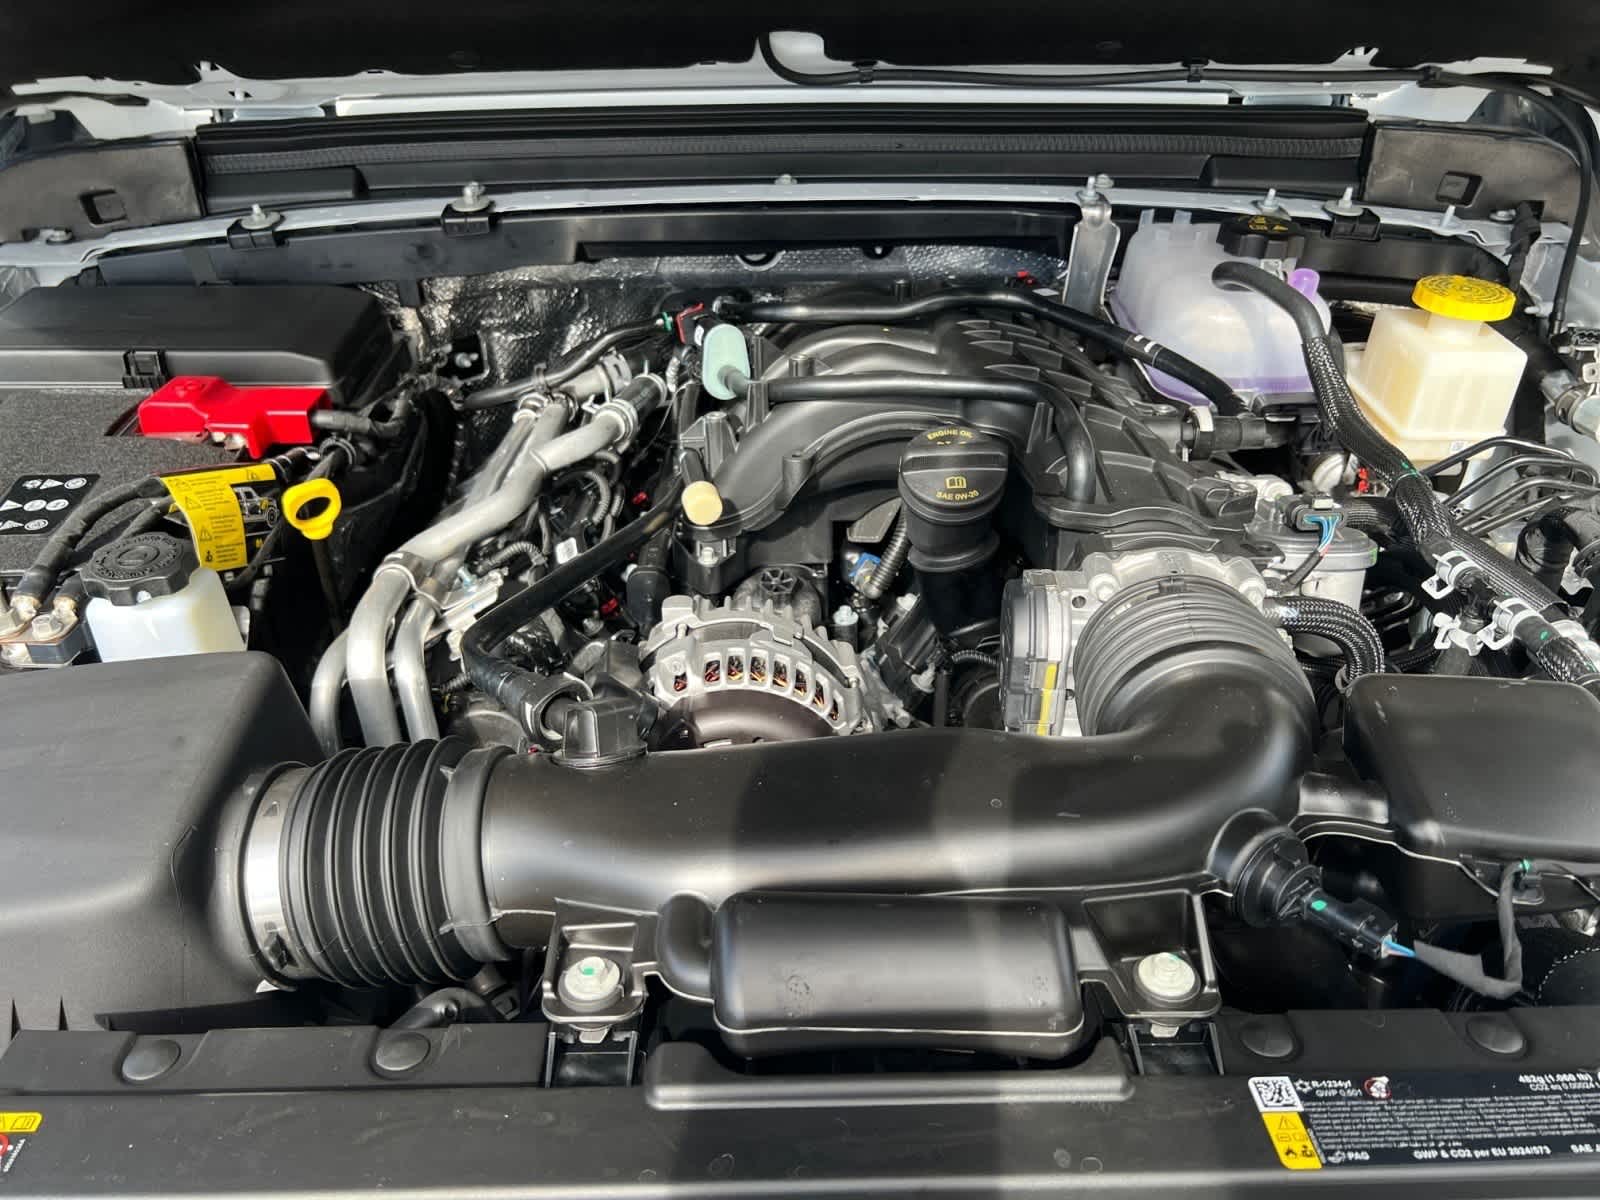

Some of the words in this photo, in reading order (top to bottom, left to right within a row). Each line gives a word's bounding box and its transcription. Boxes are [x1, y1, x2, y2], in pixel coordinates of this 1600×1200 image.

[927, 429, 958, 440] ENGINE
[960, 430, 974, 439] OIL
[936, 491, 954, 500] SAE
[955, 490, 979, 500] 0W-20
[1413, 1149, 1438, 1159] GWP
[1440, 1149, 1449, 1158] &
[1450, 1148, 1473, 1158] CO2
[1491, 1146, 1507, 1157] EU
[1570, 1143, 1594, 1153] SAE
